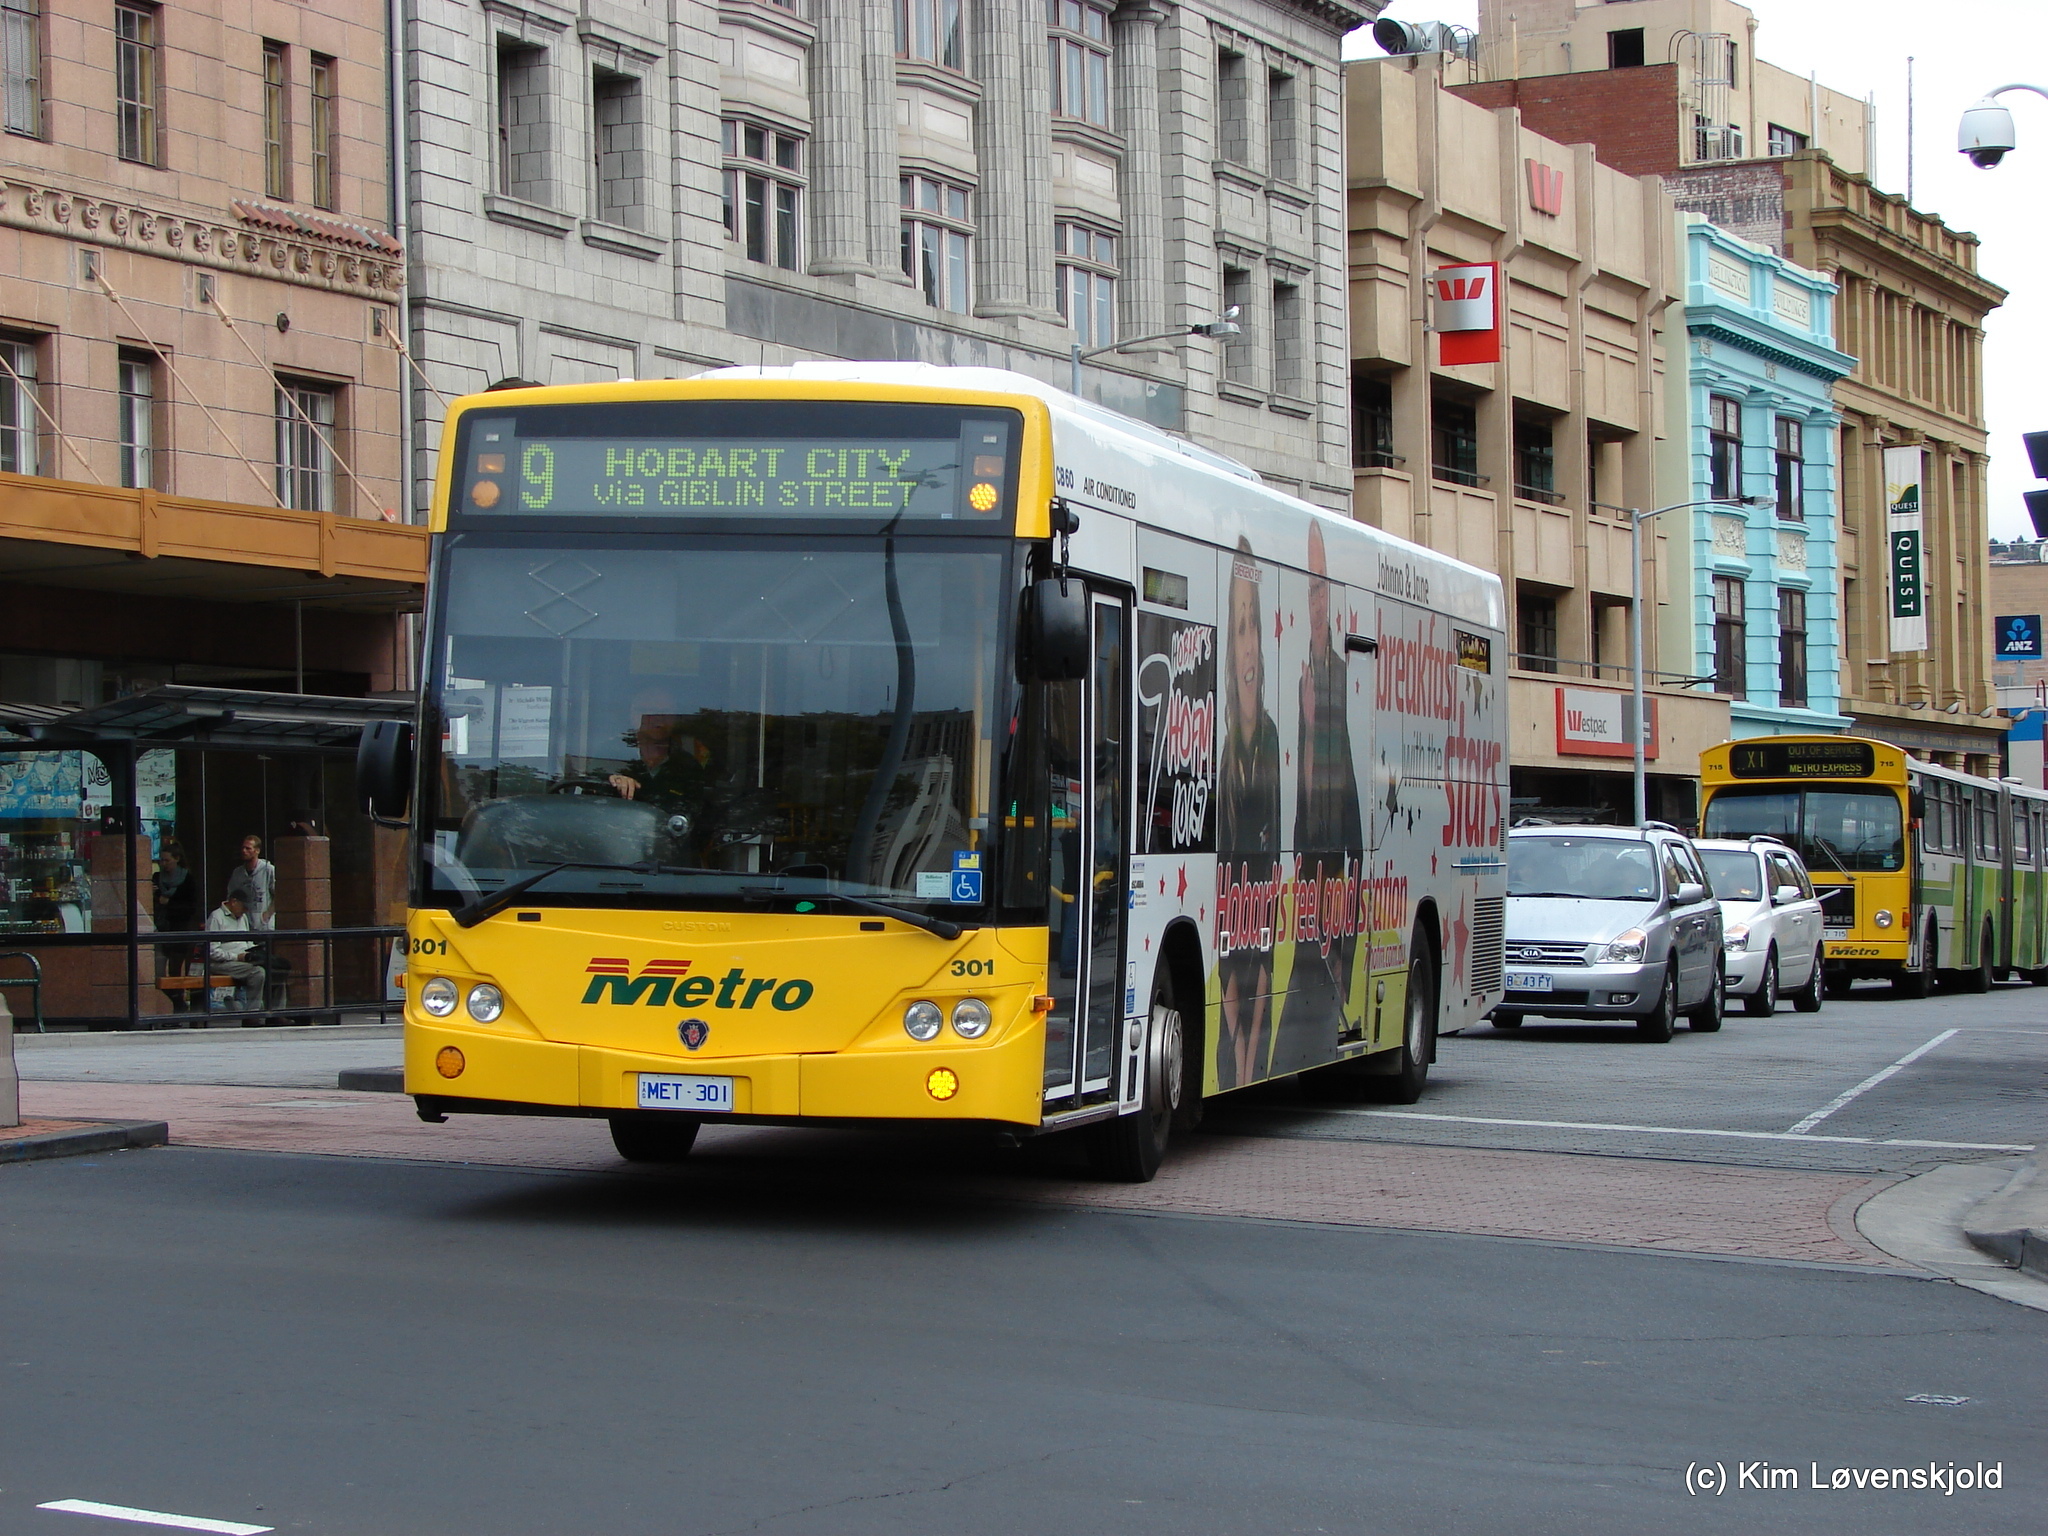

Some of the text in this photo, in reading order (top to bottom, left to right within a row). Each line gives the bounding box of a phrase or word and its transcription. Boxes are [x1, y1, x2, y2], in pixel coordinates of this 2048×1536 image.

[521, 443, 555, 509] 9
[605, 447, 912, 479] HOBART CITY
[593, 481, 918, 508] via GIBLIN STREET
[1083, 476, 1136, 510] AIR CONDITIONED
[1891, 501, 1918, 511] QUEST
[1377, 553, 1429, 605] Johnno & Jane
[1897, 537, 1914, 612] QUEST
[2004, 640, 2033, 652] ANZ
[1376, 607, 1458, 721] breakfast
[1567, 710, 1607, 737] Westpac
[1403, 731, 1443, 790] with the
[1788, 746, 1807, 755] OUT
[1809, 746, 1821, 754] OF
[1824, 745, 1861, 755] SERVICE
[1442, 701, 1501, 848] stars
[1789, 764, 1862, 773] METRO EXPRESS
[1213, 860, 1288, 950] Hobart's
[662, 920, 731, 933] CUSTOM
[412, 938, 447, 956] 301
[1830, 946, 1880, 956] Metro
[951, 959, 995, 977] 301
[1507, 975, 1551, 987] B 43 FY
[581, 957, 814, 1012] Metro
[647, 1082, 682, 1100] MET
[696, 1084, 727, 1102] 301
